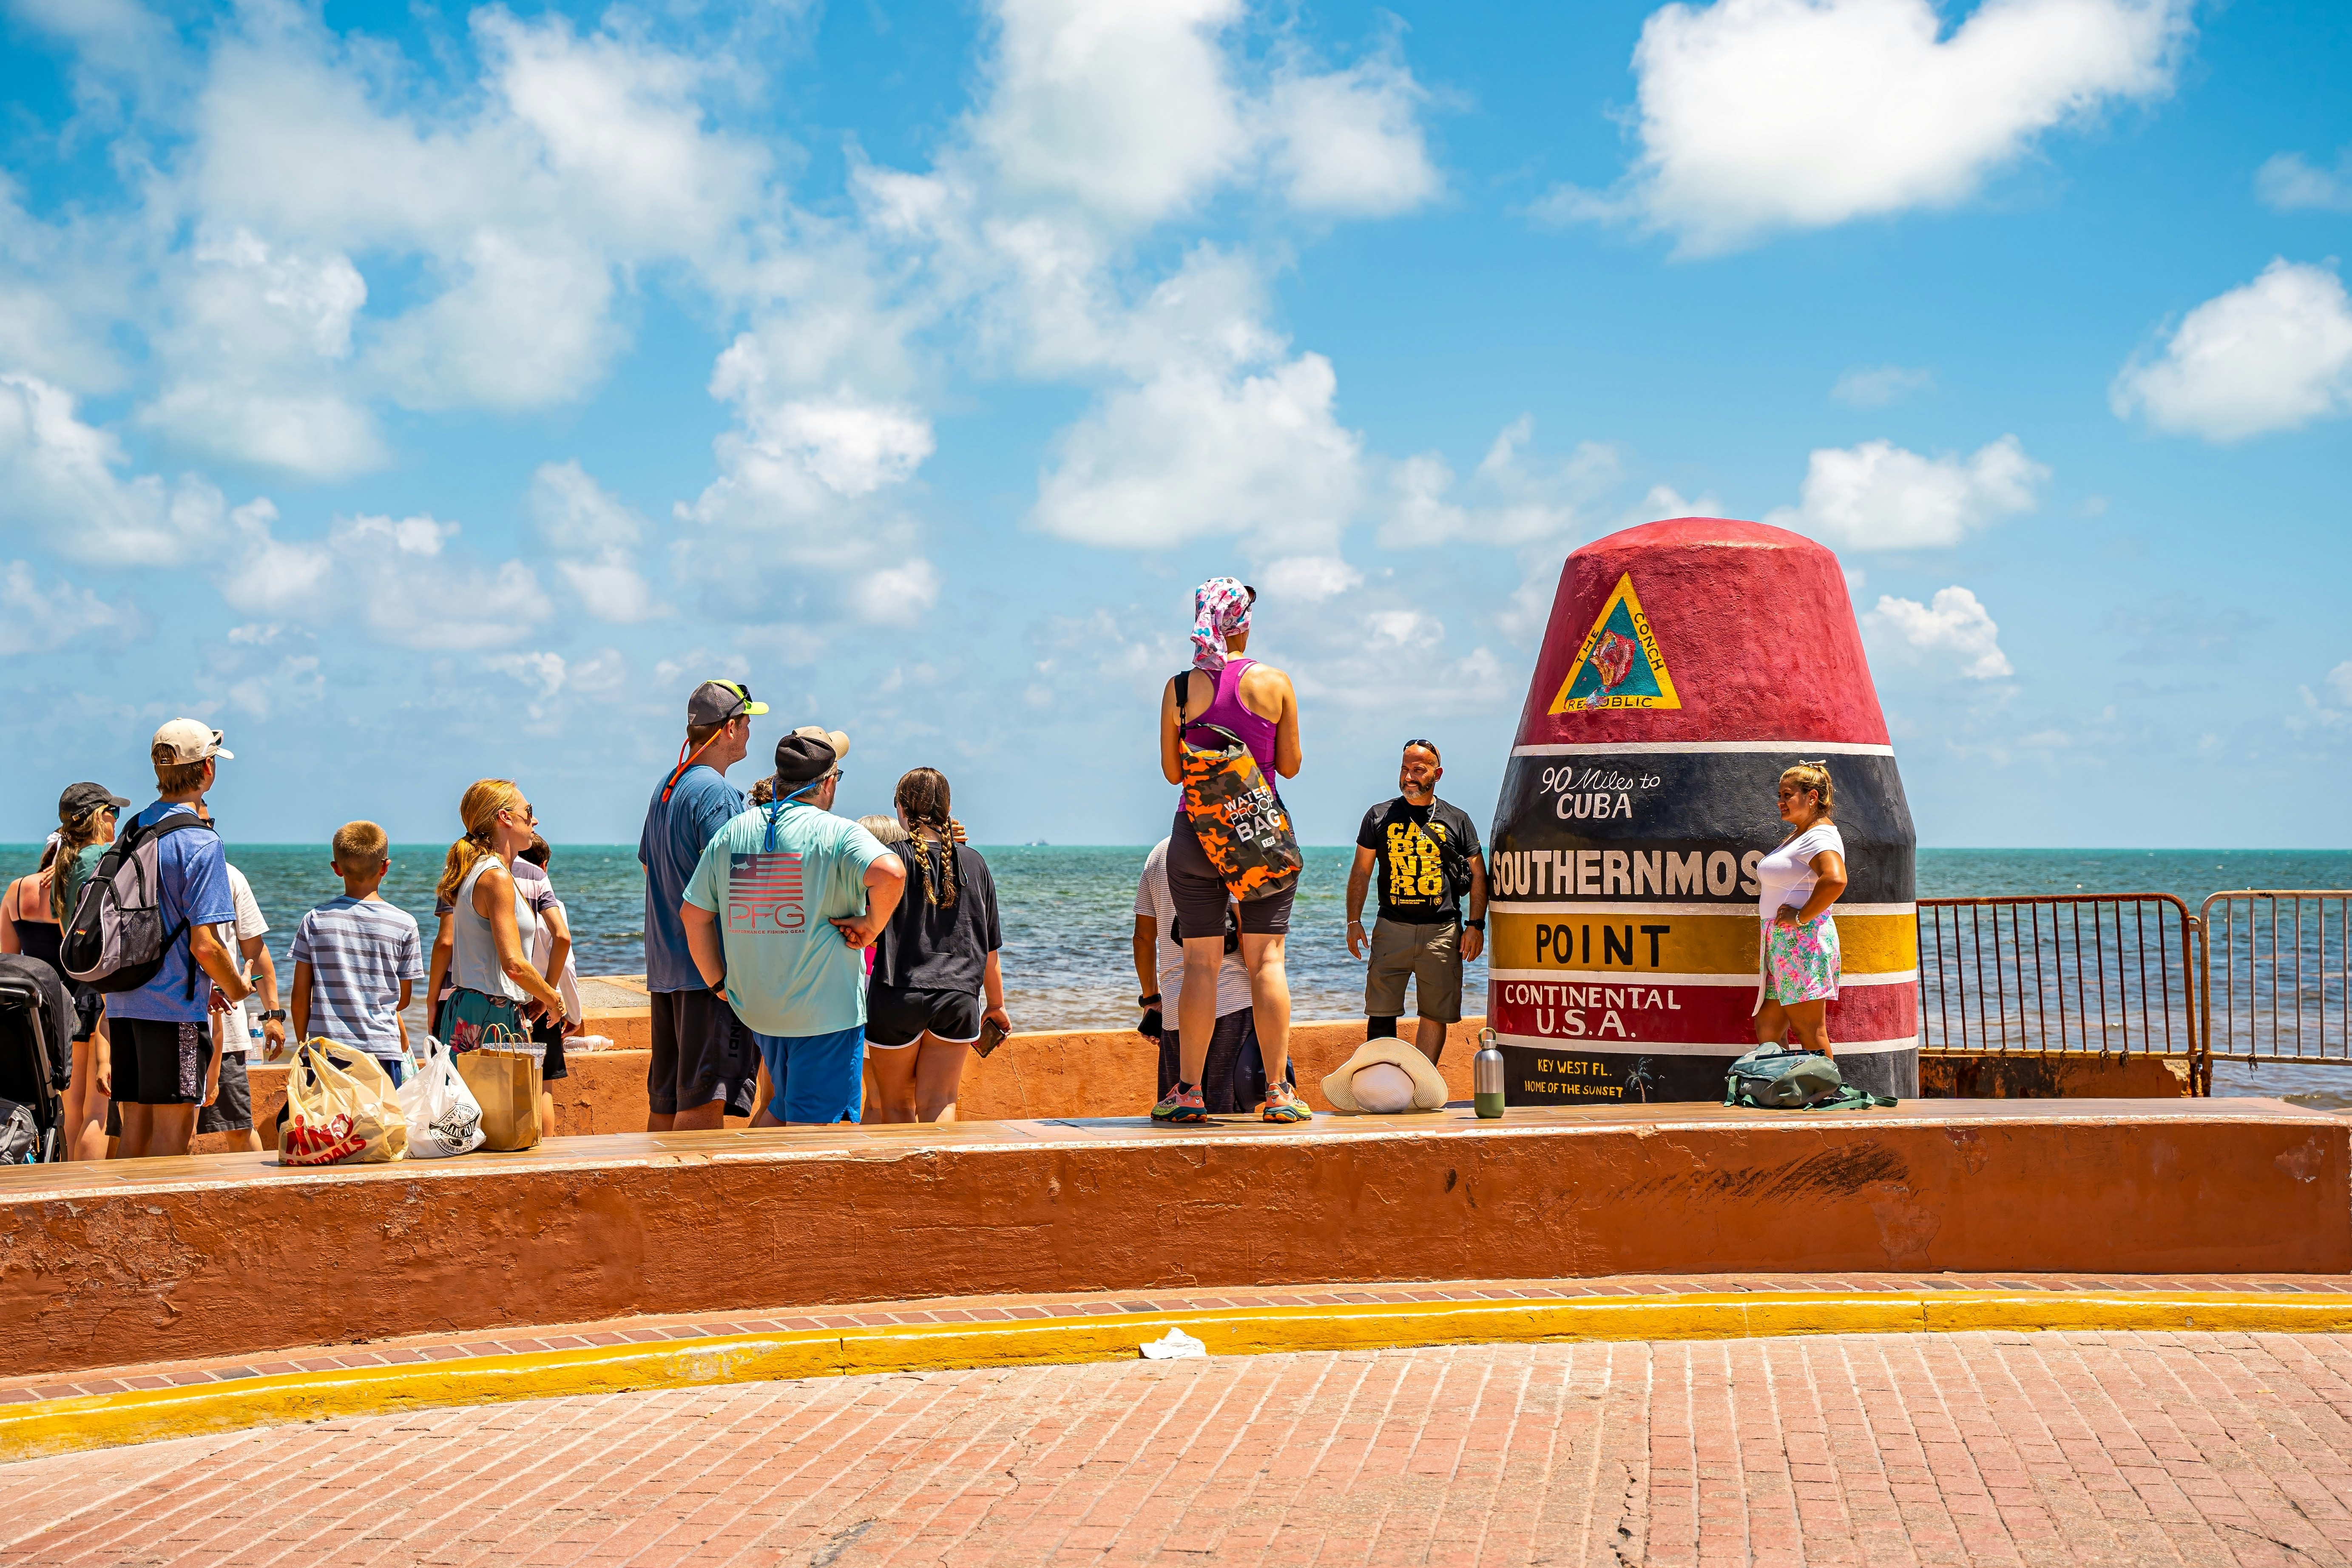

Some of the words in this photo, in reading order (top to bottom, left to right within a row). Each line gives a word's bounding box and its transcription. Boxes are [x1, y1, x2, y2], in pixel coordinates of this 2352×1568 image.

[1575, 629, 1599, 664] THE
[1634, 613, 1664, 671] CONCH
[1568, 697, 1652, 710] REUBLIC
[1540, 767, 1572, 794] 90
[1568, 768, 1633, 790] Miles
[1639, 773, 1660, 789] to
[1224, 785, 1270, 812] WATER
[1229, 795, 1274, 825] PROOF
[1557, 793, 1632, 819] CUBA
[1235, 809, 1281, 842] BAG
[1264, 838, 1275, 846] 15L
[1386, 839, 1440, 857] BO
[1389, 855, 1442, 876] NE
[1493, 850, 1761, 896] SOUTHERNMOS
[1390, 875, 1442, 895] RO
[728, 903, 805, 929] PFG
[1536, 923, 1670, 967] POINT
[1505, 984, 1681, 1009] CONTINENTAL
[1537, 1008, 1636, 1037] U.S.A.
[1538, 1059, 1553, 1072] KEY
[1557, 1060, 1588, 1075] WEST
[1593, 1063, 1612, 1076] FL.
[1525, 1080, 1546, 1092] HOME
[1548, 1082, 1559, 1094] OF
[1561, 1084, 1580, 1095] THE
[1582, 1085, 1624, 1098] SUNSET
[459, 1106, 474, 1116] FOOD
[433, 1131, 455, 1152] SUPERIOR
[443, 1125, 463, 1137] HANK
